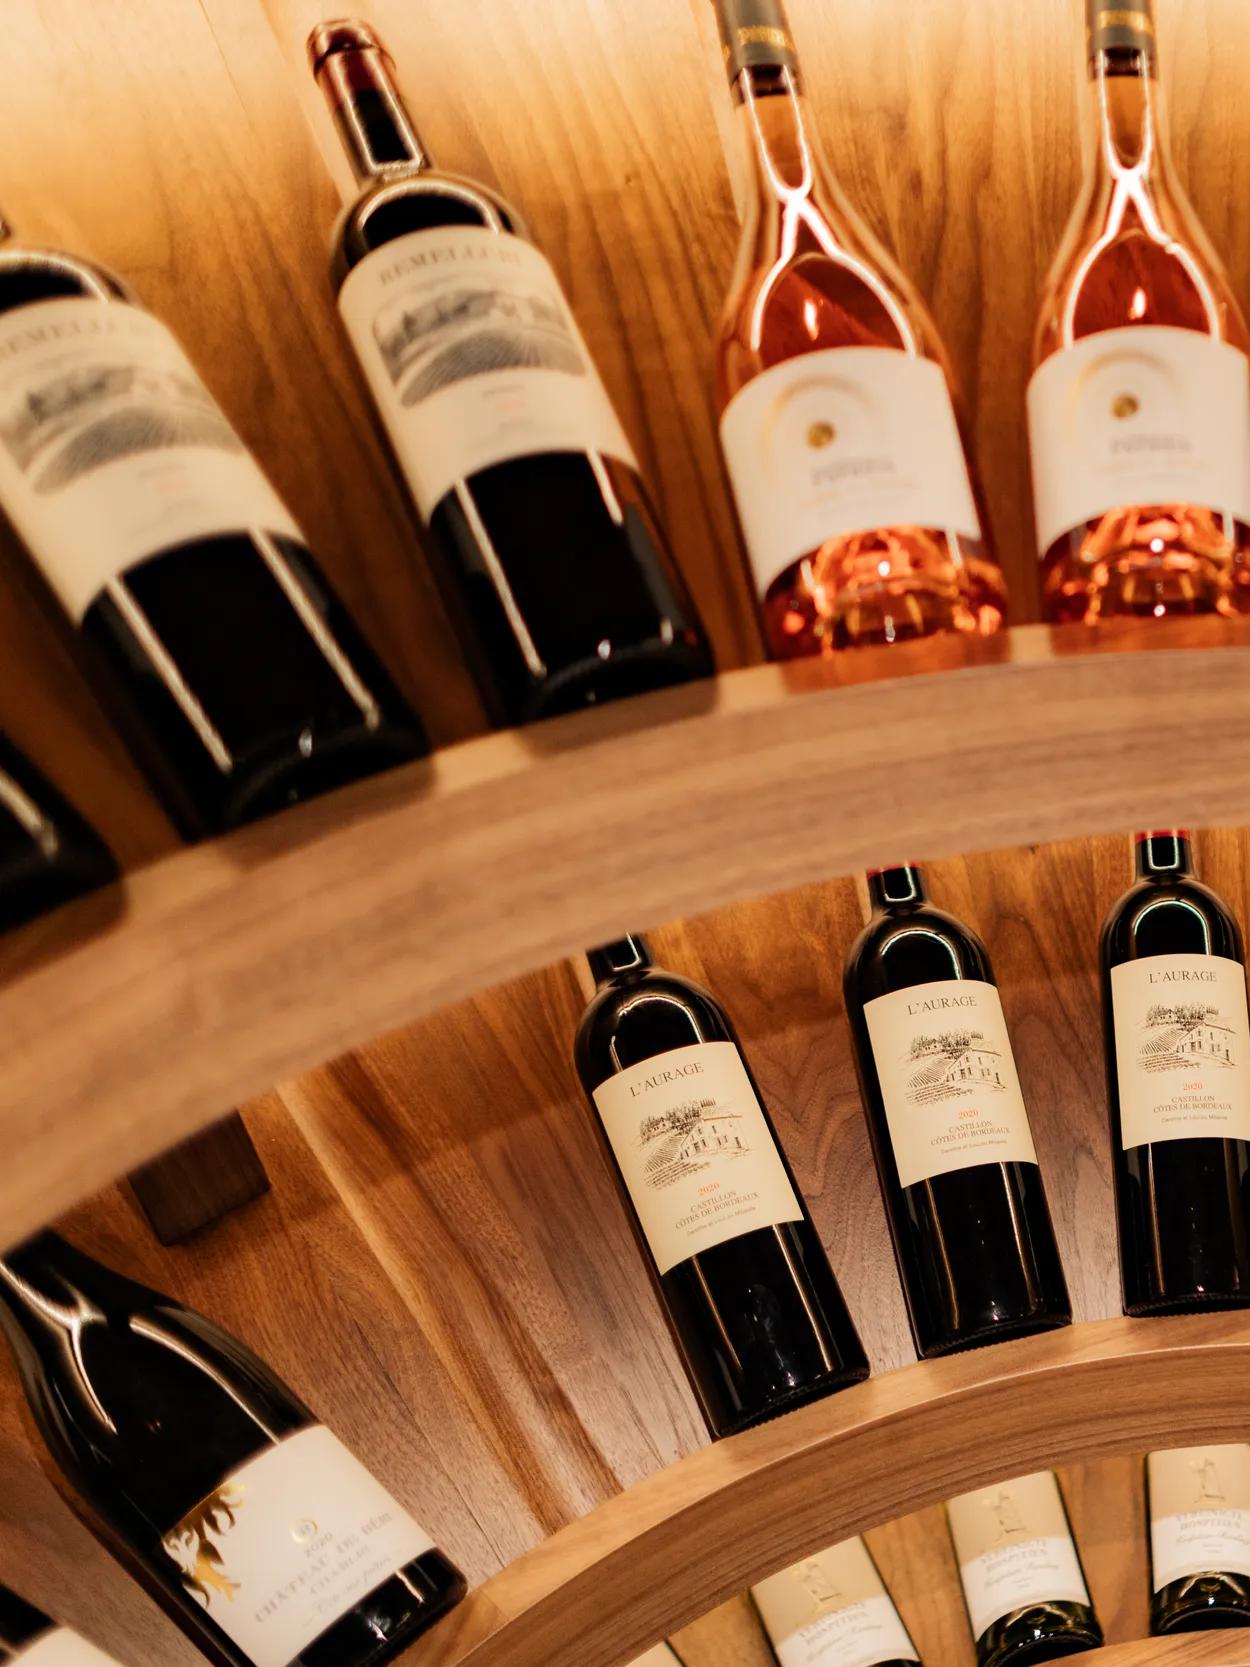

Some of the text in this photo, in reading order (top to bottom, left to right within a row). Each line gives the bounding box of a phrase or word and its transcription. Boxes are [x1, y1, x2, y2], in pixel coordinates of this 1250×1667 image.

[1149, 970, 1217, 984] L'AURAGE
[907, 995, 977, 1015] L'AURAGE
[630, 1061, 705, 1097] L'AURAGE
[948, 1120, 993, 1134] CASTILLON
[697, 1182, 720, 1197] 2020
